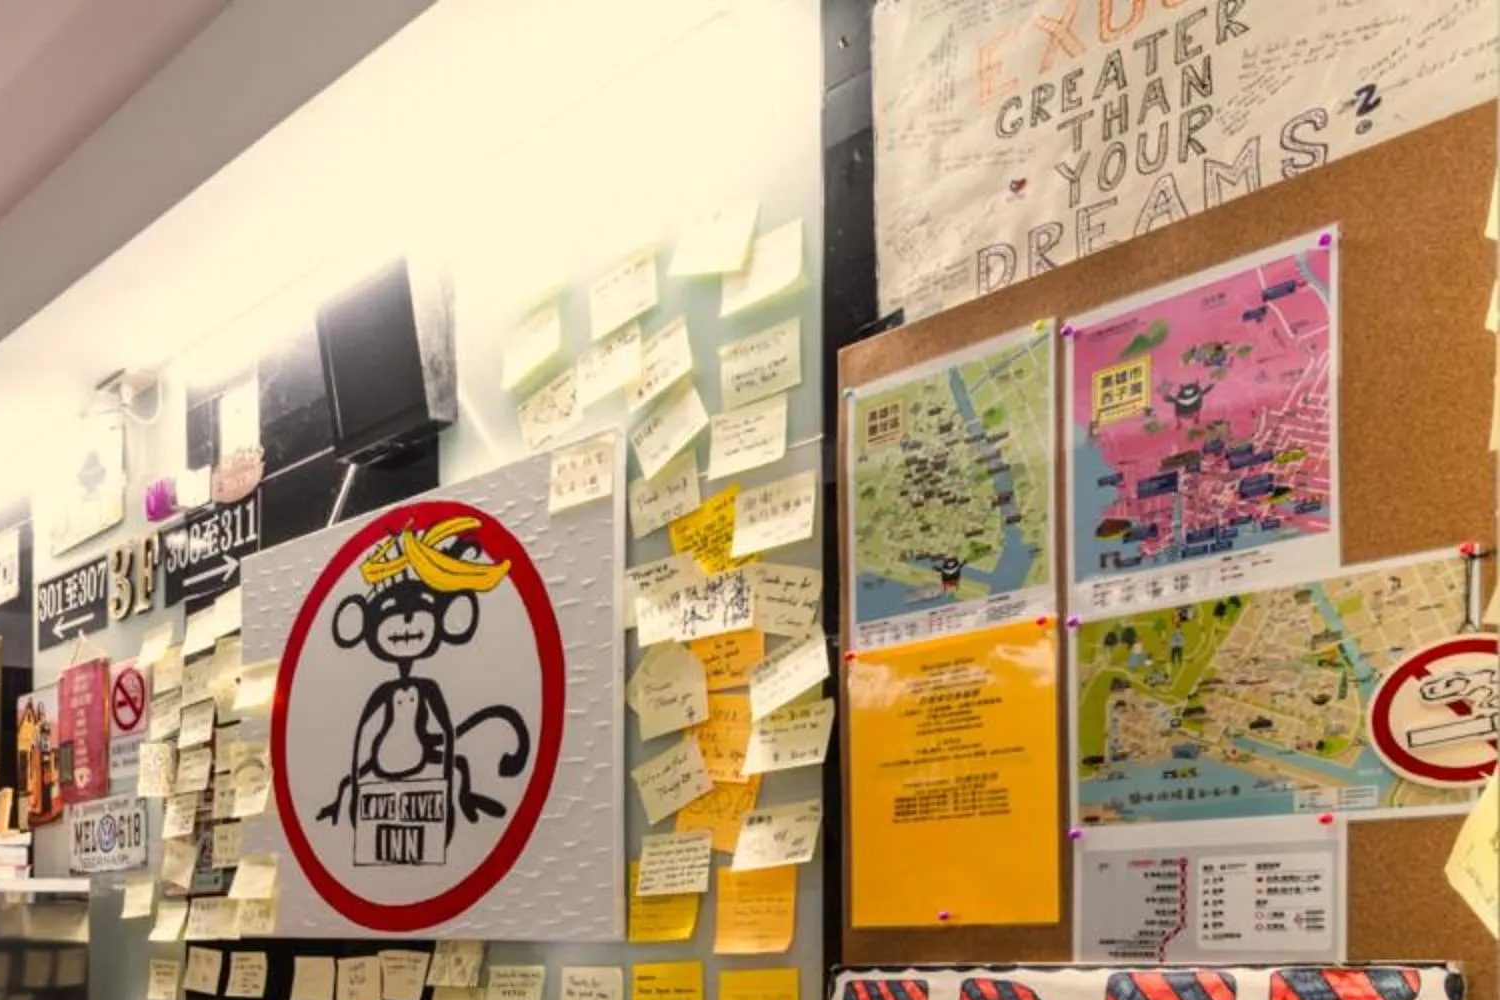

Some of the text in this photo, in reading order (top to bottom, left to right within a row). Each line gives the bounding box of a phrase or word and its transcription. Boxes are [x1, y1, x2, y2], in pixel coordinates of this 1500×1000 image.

[996, 0, 1250, 138] GREATER
[1056, 54, 1213, 153] THAN
[1055, 104, 1213, 208] YOUR
[38, 560, 108, 623] 301至307
[380, 828, 419, 862] INN
